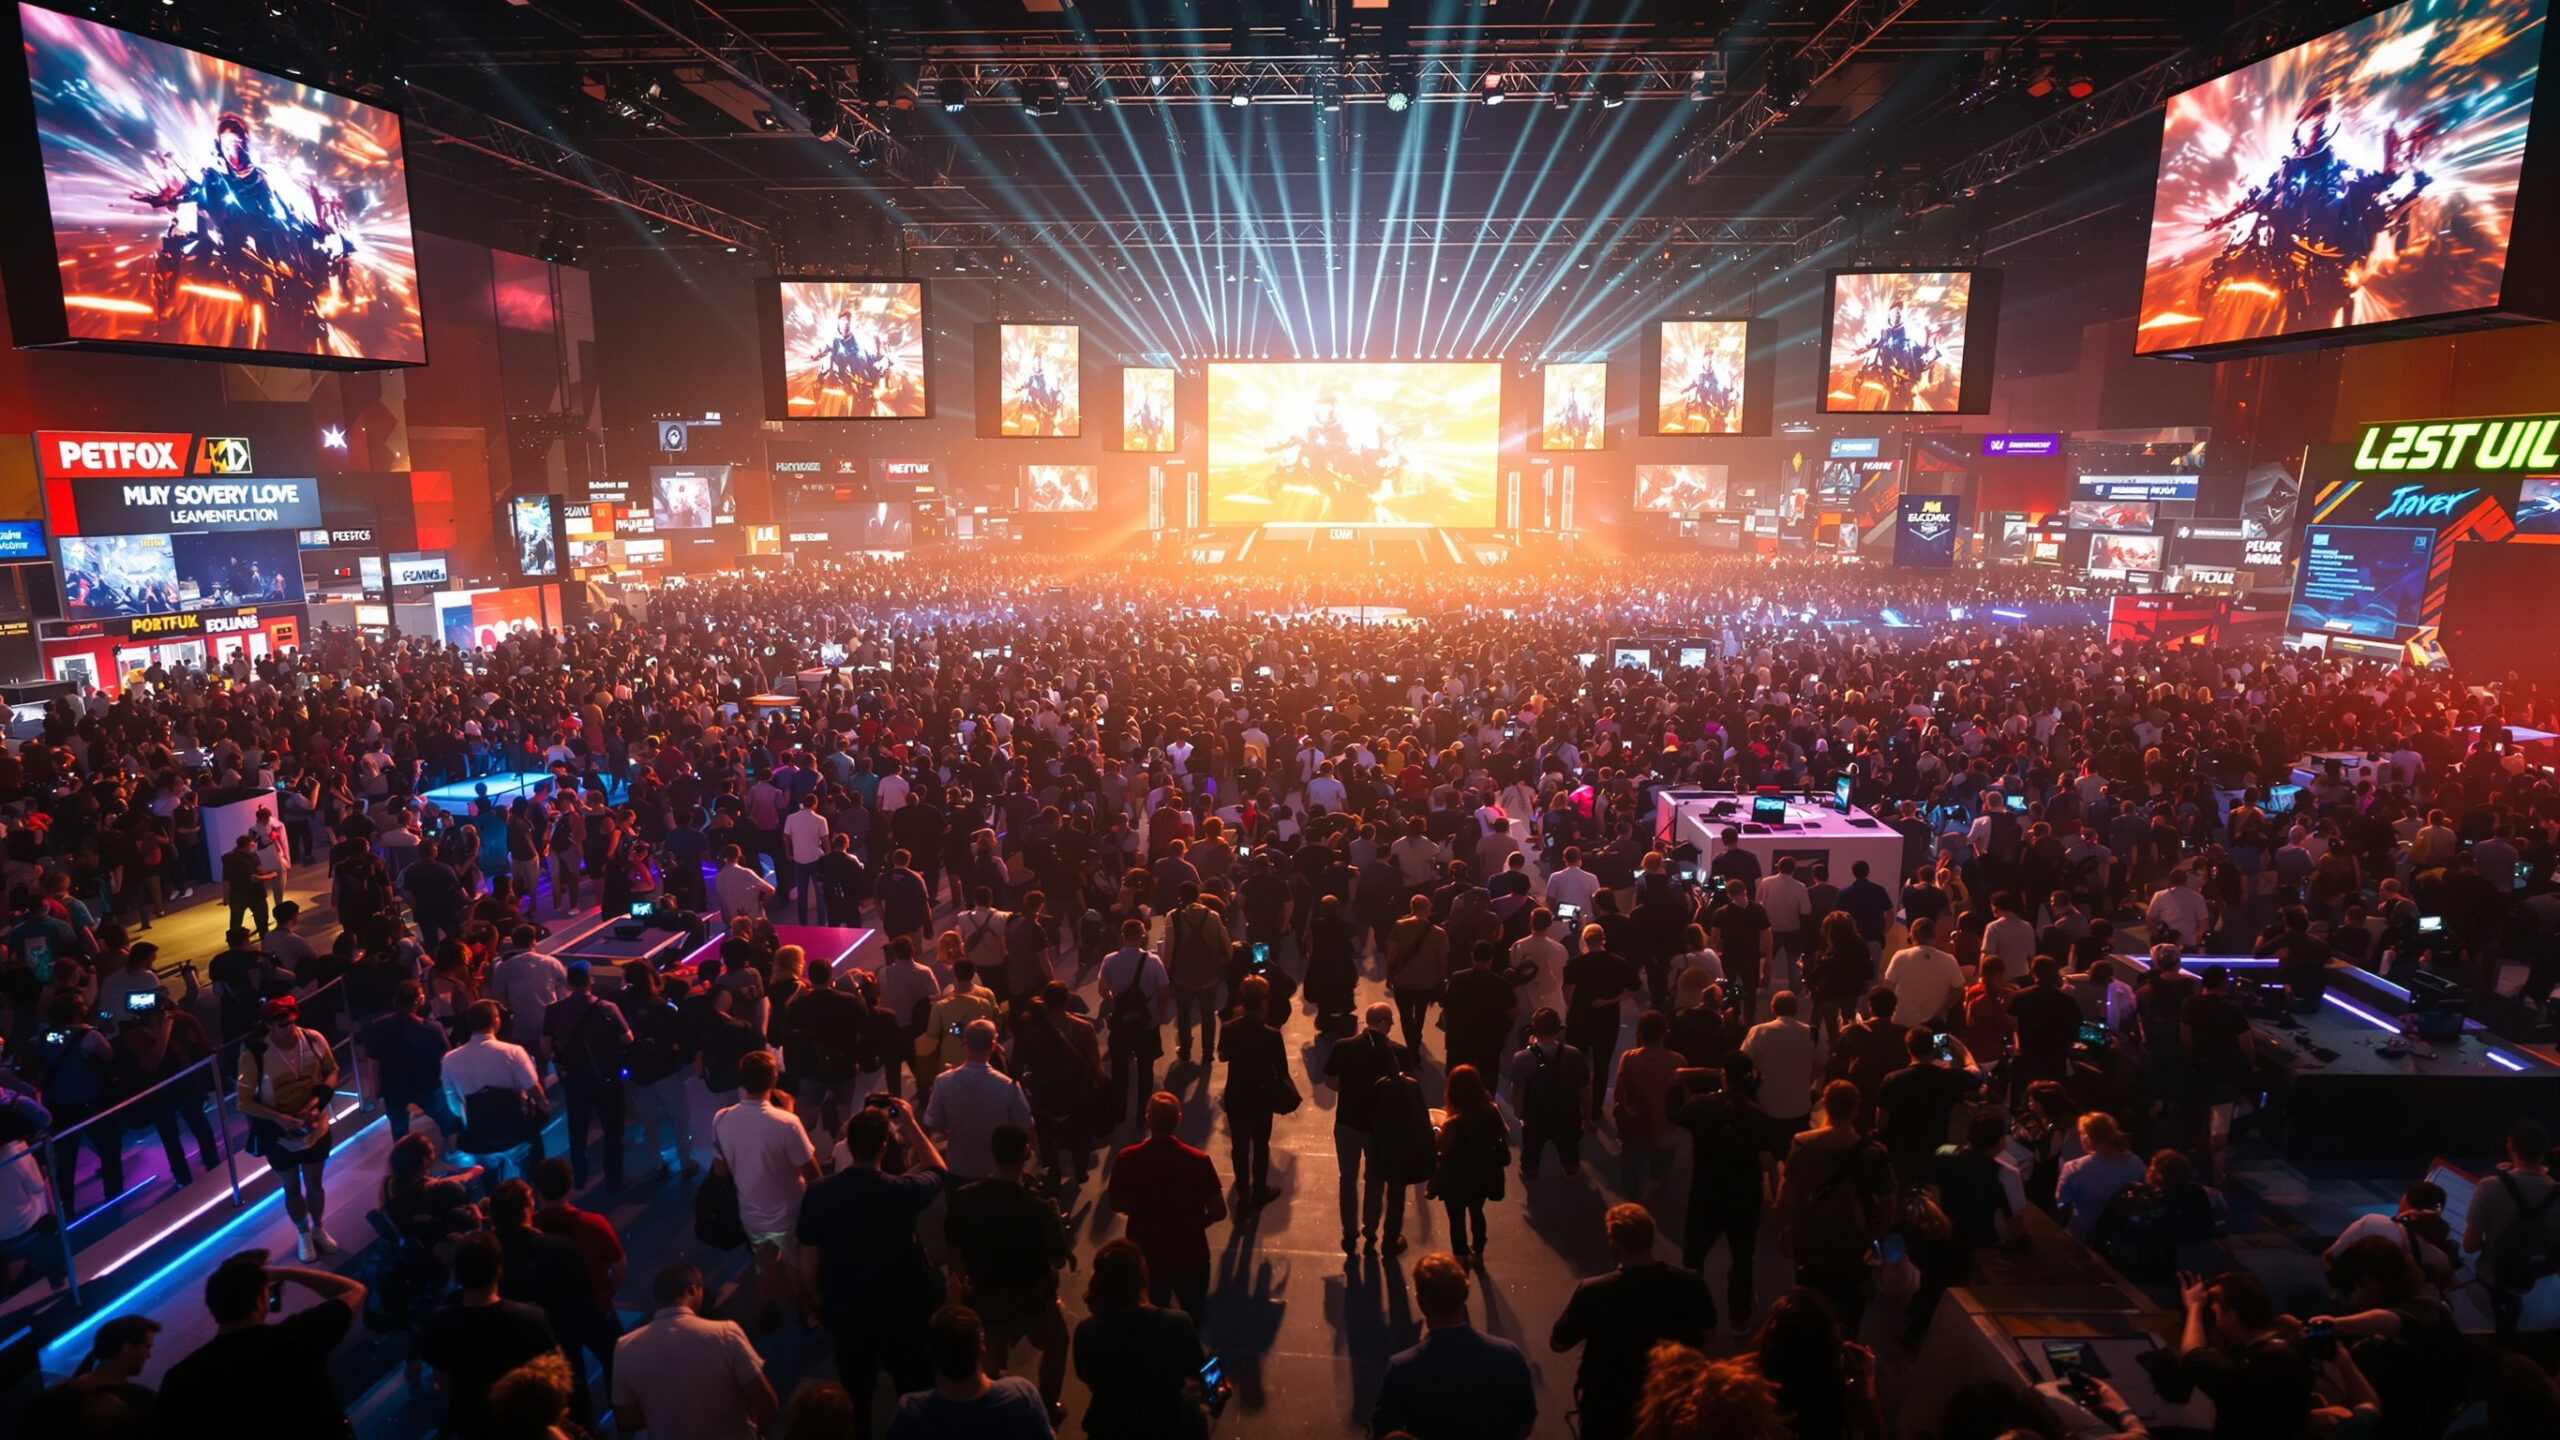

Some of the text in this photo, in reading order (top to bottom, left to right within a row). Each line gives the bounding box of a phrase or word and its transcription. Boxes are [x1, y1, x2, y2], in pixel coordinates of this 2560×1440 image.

[58, 441, 179, 470] PETFOX
[174, 484, 249, 505] SOVERY
[252, 483, 300, 504] LOVE
